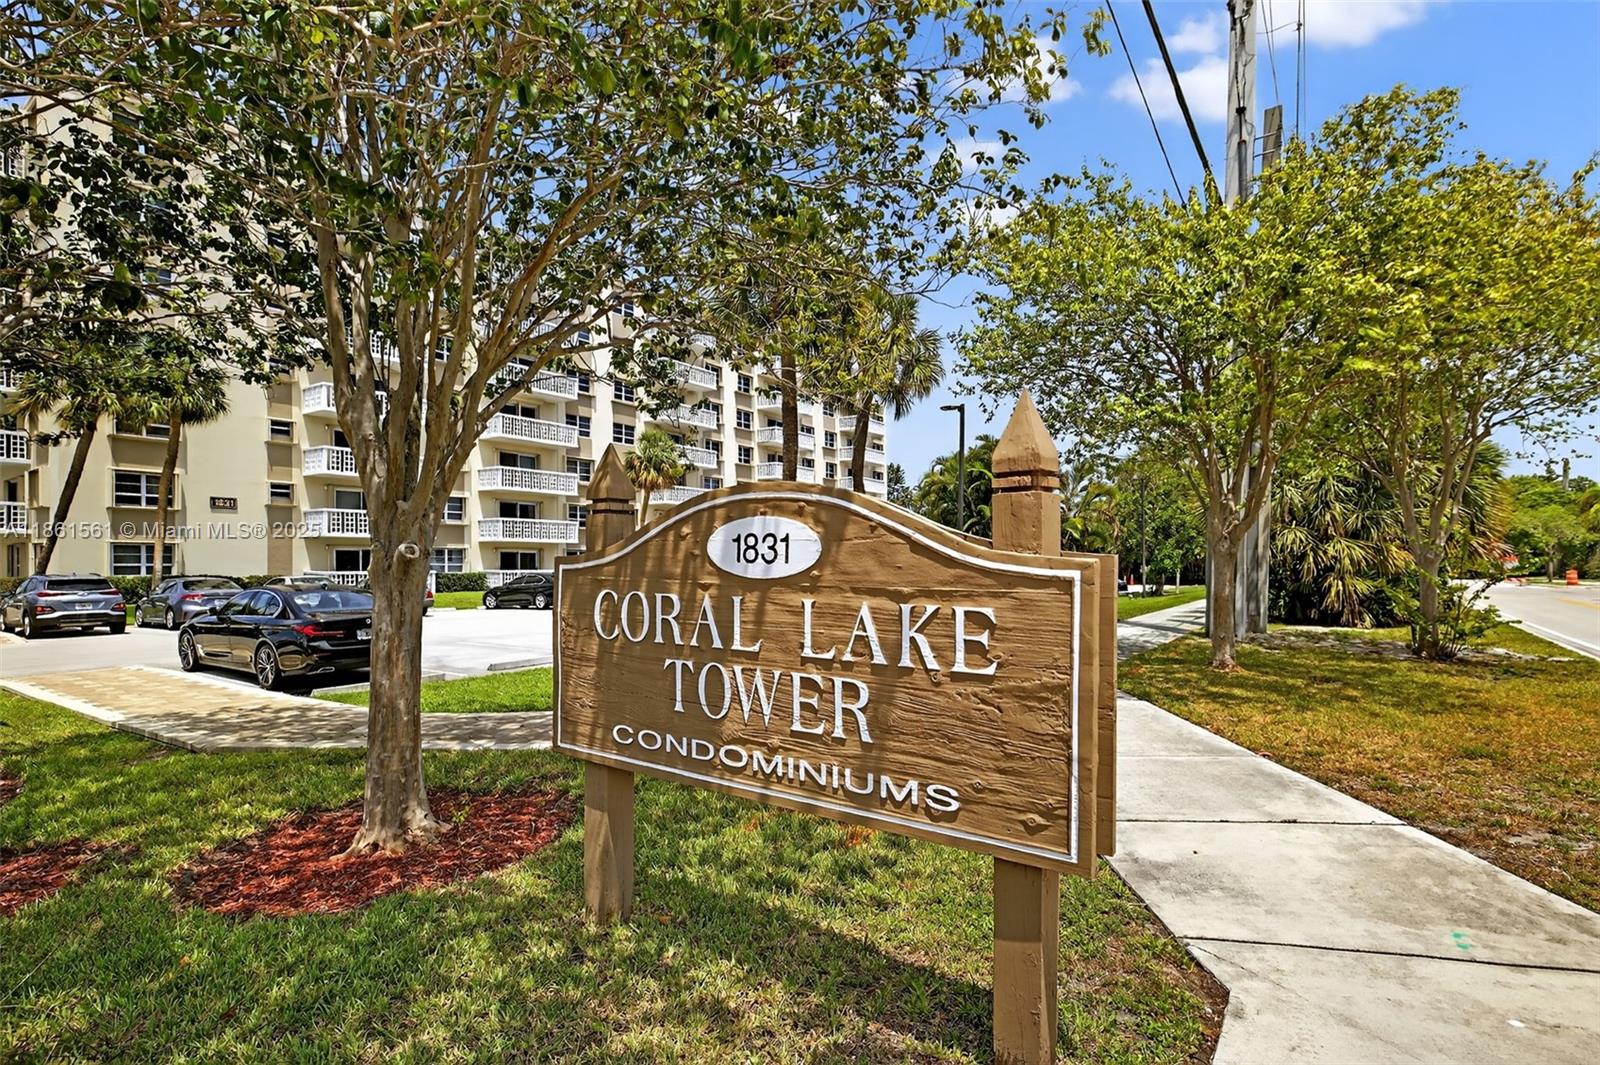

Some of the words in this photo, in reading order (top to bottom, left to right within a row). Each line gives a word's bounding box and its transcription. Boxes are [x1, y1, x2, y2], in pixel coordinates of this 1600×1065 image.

[731, 532, 790, 565] 1831
[593, 589, 764, 653] CORAL
[799, 599, 999, 676] LAKE
[664, 657, 873, 744] TOWER
[612, 724, 961, 812] CONDOMINIUMS
